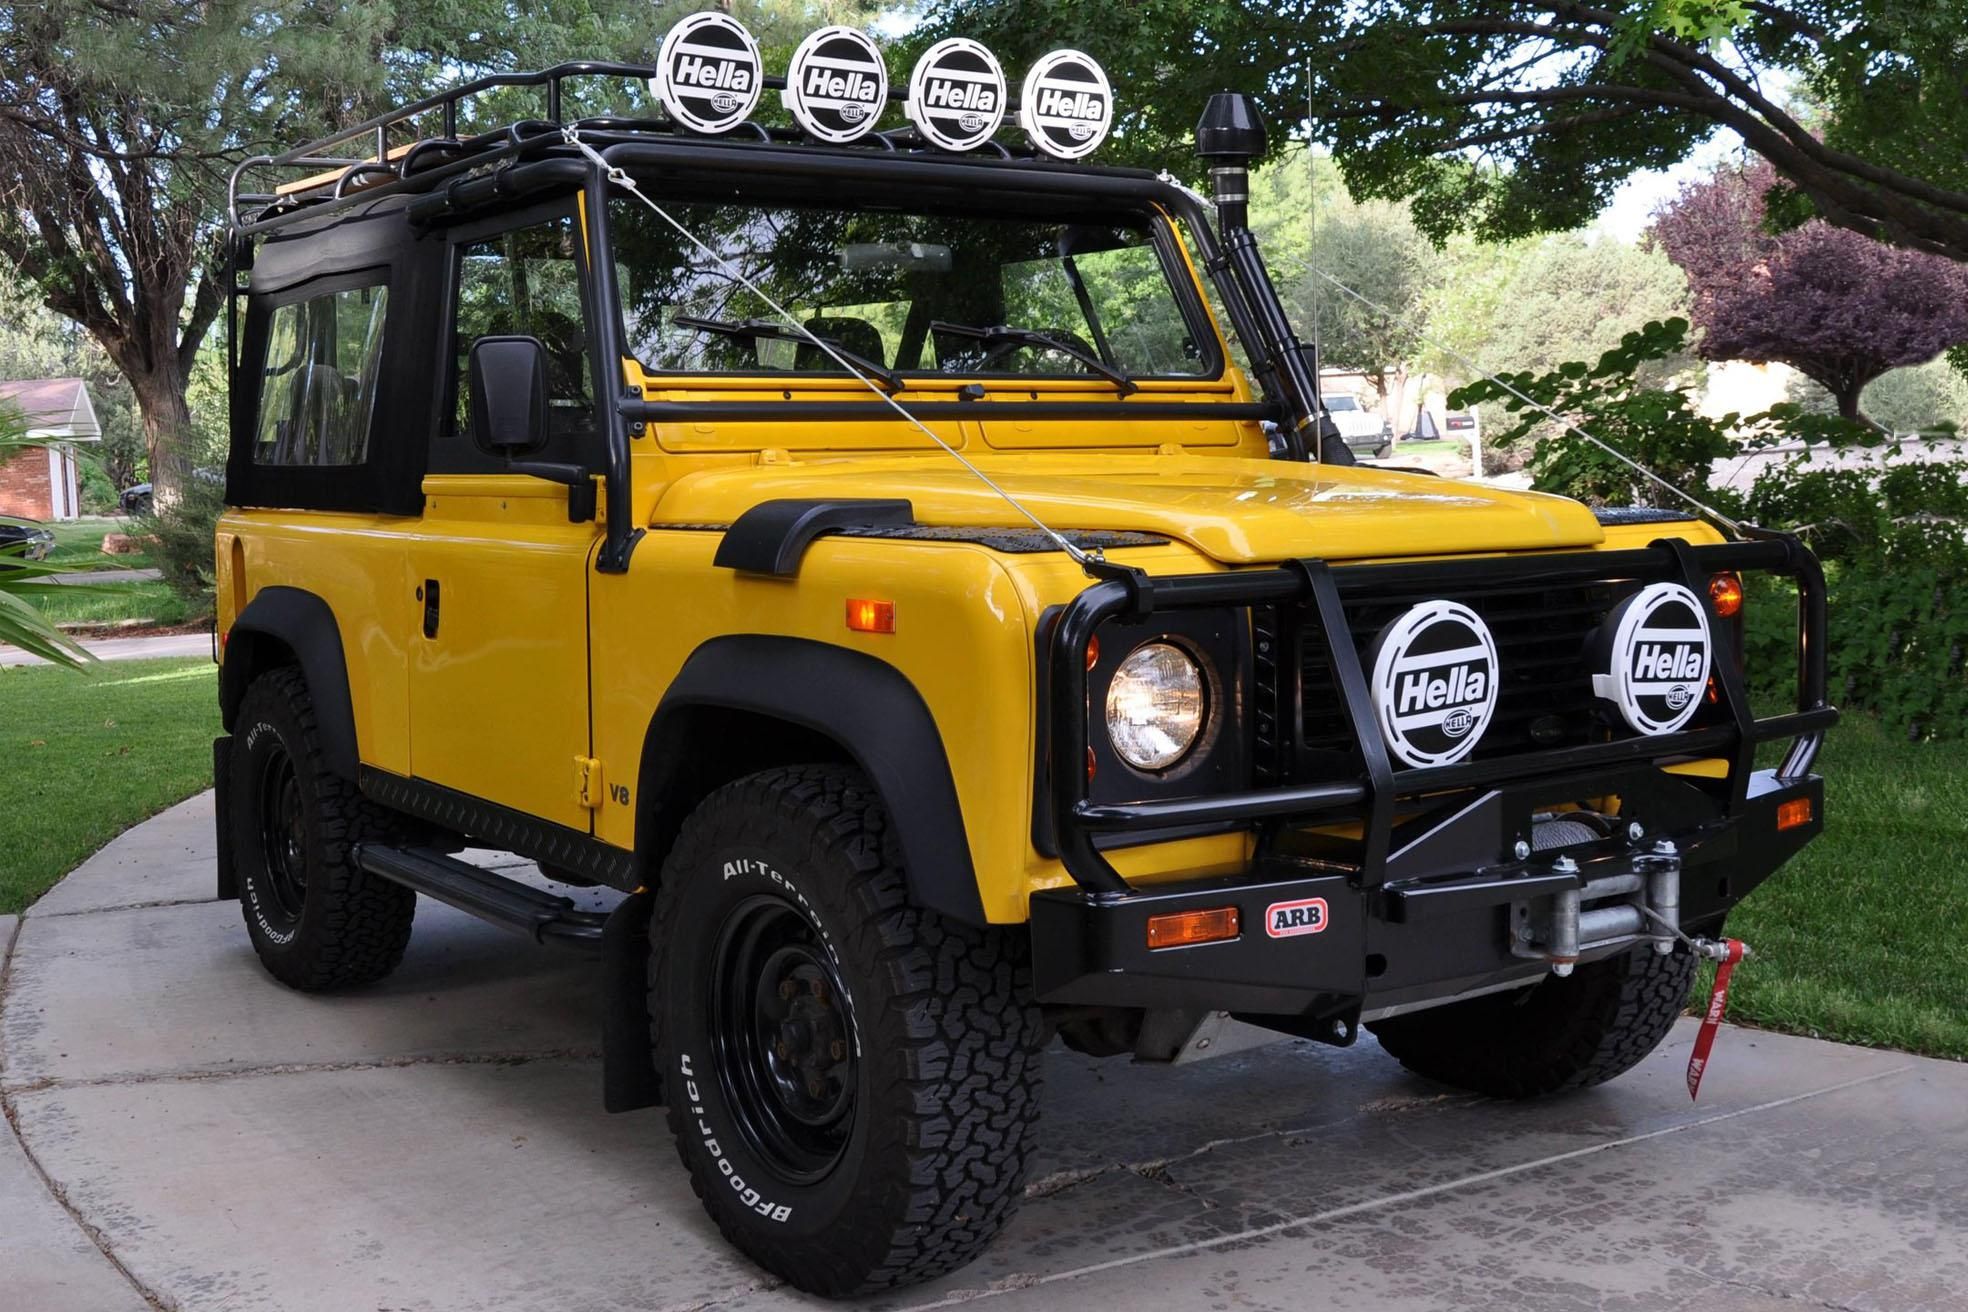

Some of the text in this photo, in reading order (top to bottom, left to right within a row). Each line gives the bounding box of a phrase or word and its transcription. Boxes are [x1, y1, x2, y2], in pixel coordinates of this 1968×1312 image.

[675, 55, 751, 92] Hella
[805, 67, 877, 101] Hella
[712, 95, 737, 109] HELLA
[926, 79, 996, 111] Hella
[1038, 88, 1103, 120] Hella
[841, 106, 865, 118] HELLA
[960, 116, 984, 128] HELLA
[1070, 125, 1093, 136] HELLA
[1634, 644, 1702, 679] Hella
[1398, 664, 1486, 713] Hella
[1668, 690, 1690, 702] HELLA
[1445, 713, 1473, 729] HELLA
[609, 782, 630, 807] V8
[1274, 906, 1321, 930] ARB
[1706, 989, 1725, 1025] WARN
[680, 1053, 793, 1224] BFGoodrich
